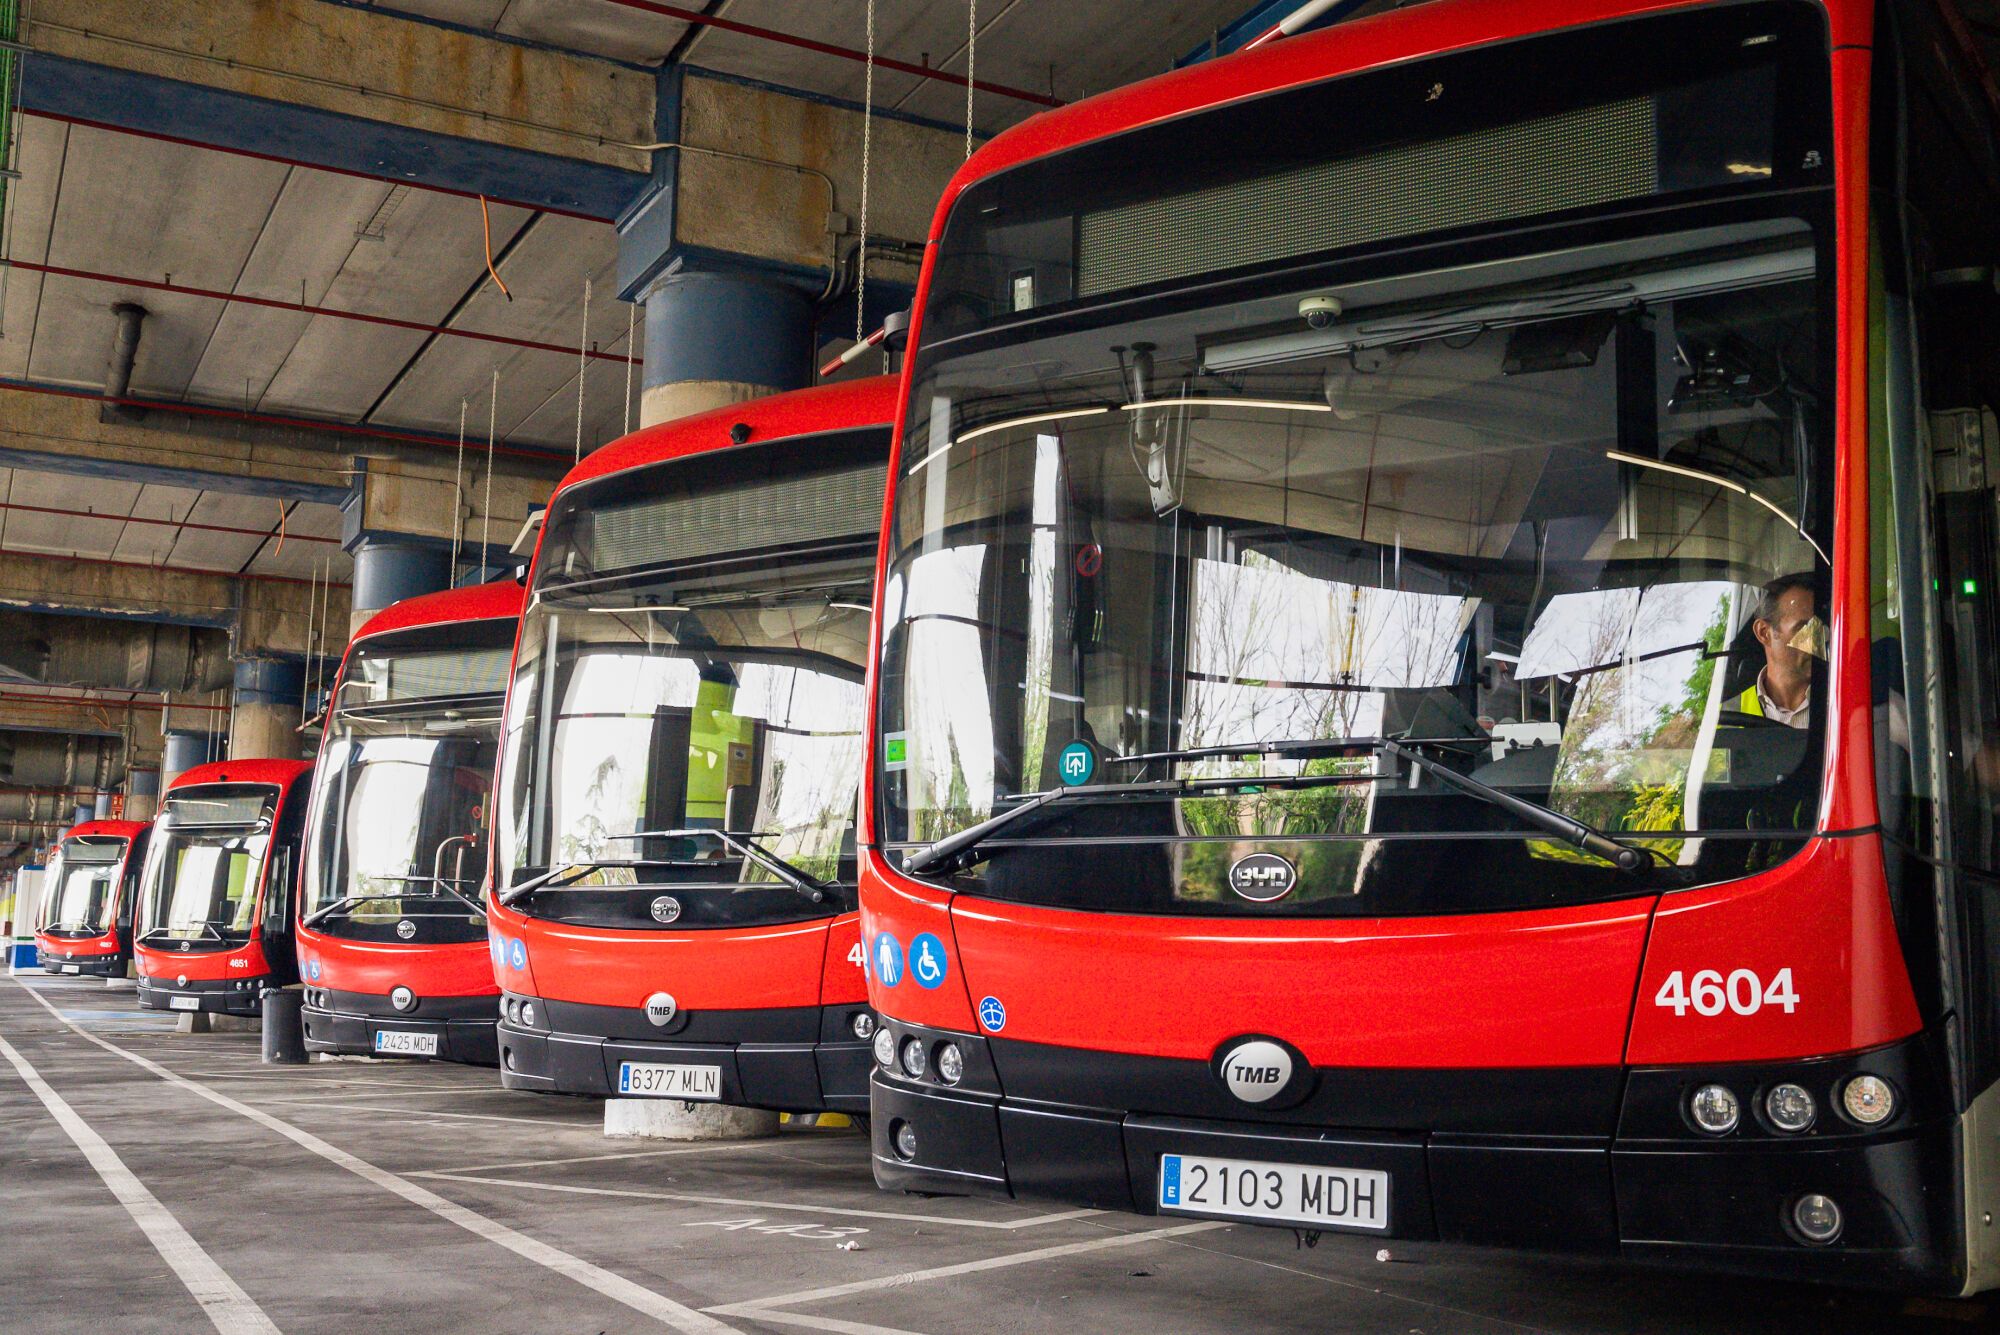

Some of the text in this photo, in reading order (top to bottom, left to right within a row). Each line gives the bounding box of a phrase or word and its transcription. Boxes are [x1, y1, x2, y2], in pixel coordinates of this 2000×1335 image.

[229, 959, 249, 968] 4651
[1655, 968, 1800, 1016] 4604
[650, 1006, 671, 1016] TMB
[384, 1034, 410, 1050] 2425
[413, 1037, 435, 1052] MDH
[632, 1068, 676, 1090] 6377
[682, 1070, 715, 1093] MLN
[1234, 1065, 1281, 1084] TMB
[1168, 1164, 1376, 1219] E 2103 MDH
